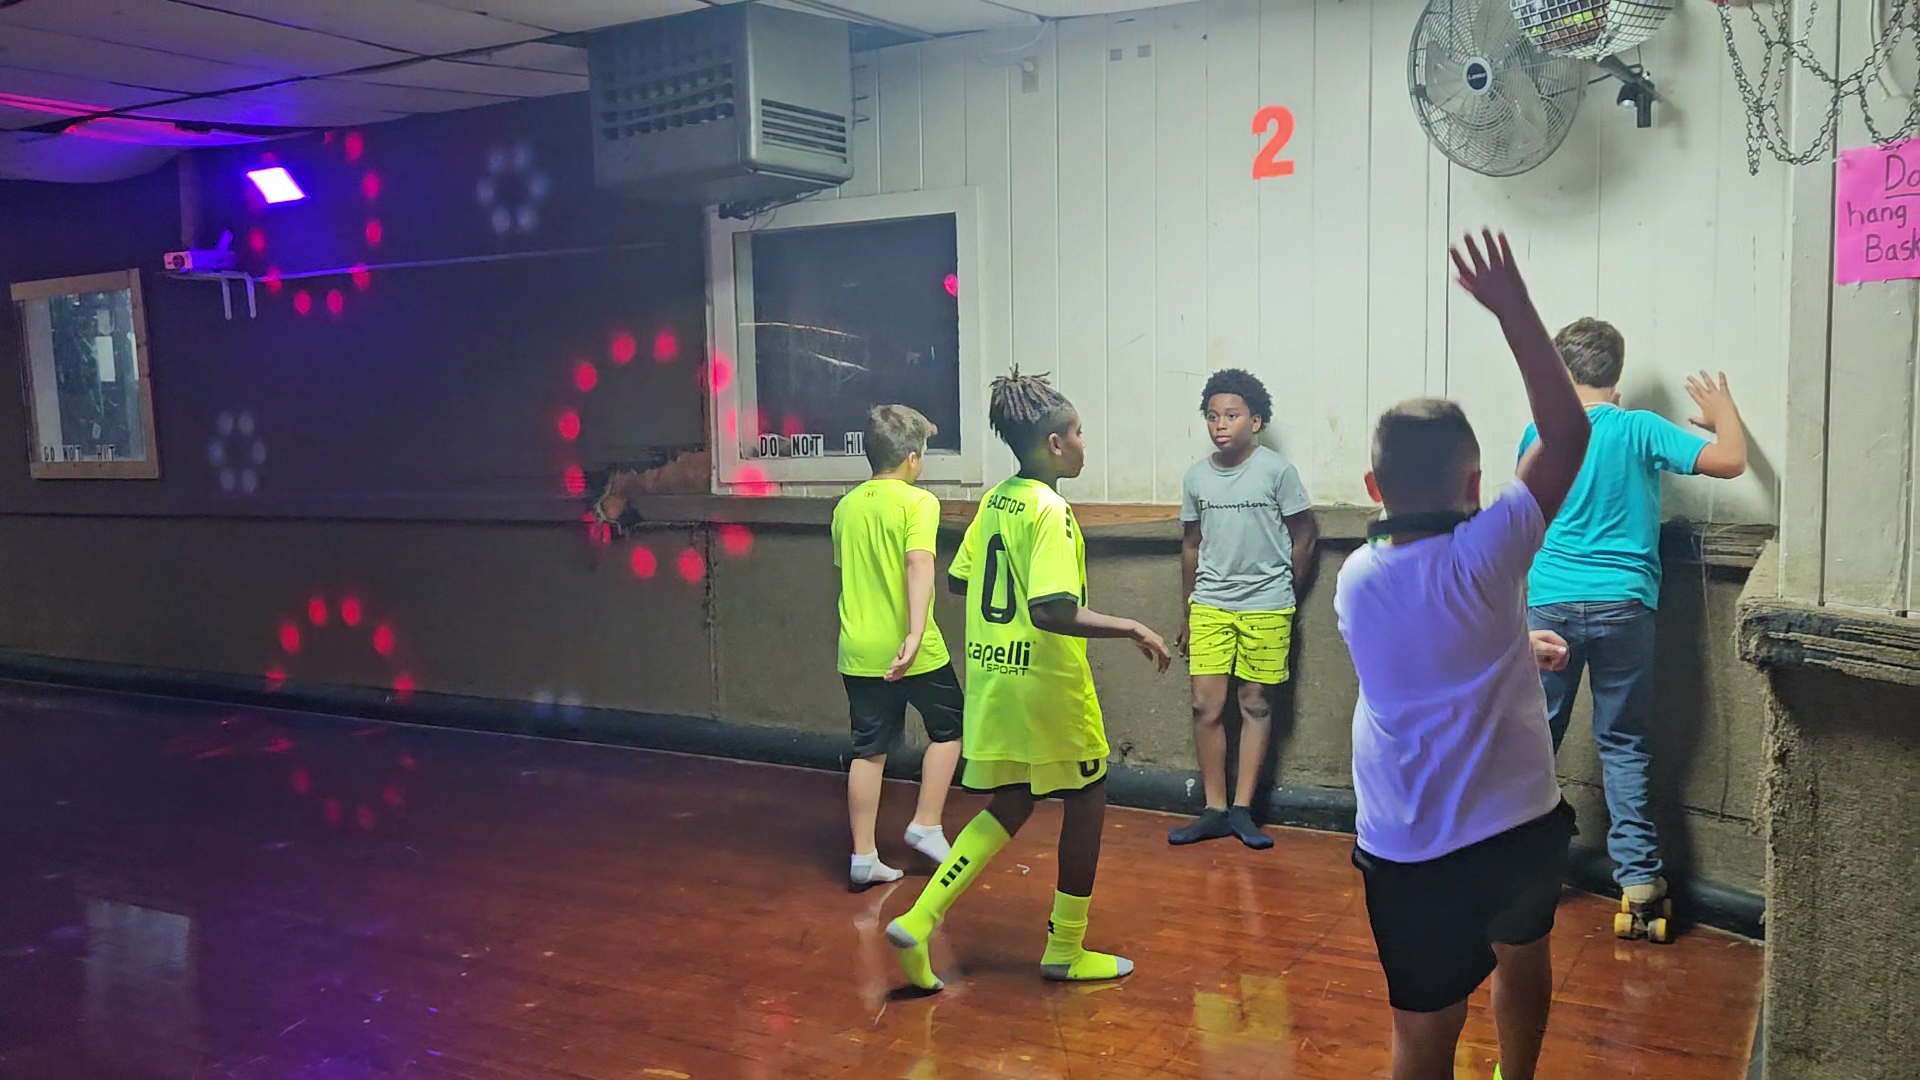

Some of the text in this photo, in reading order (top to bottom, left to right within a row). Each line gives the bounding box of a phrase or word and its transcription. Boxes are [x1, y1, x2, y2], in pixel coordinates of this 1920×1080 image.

[1251, 105, 1295, 179] 2
[1847, 201, 1907, 229] hang
[759, 432, 864, 456] DO NOT HI
[1199, 500, 1268, 513] Champion
[968, 641, 1031, 667] capelli
[986, 663, 1029, 676] SPORT
